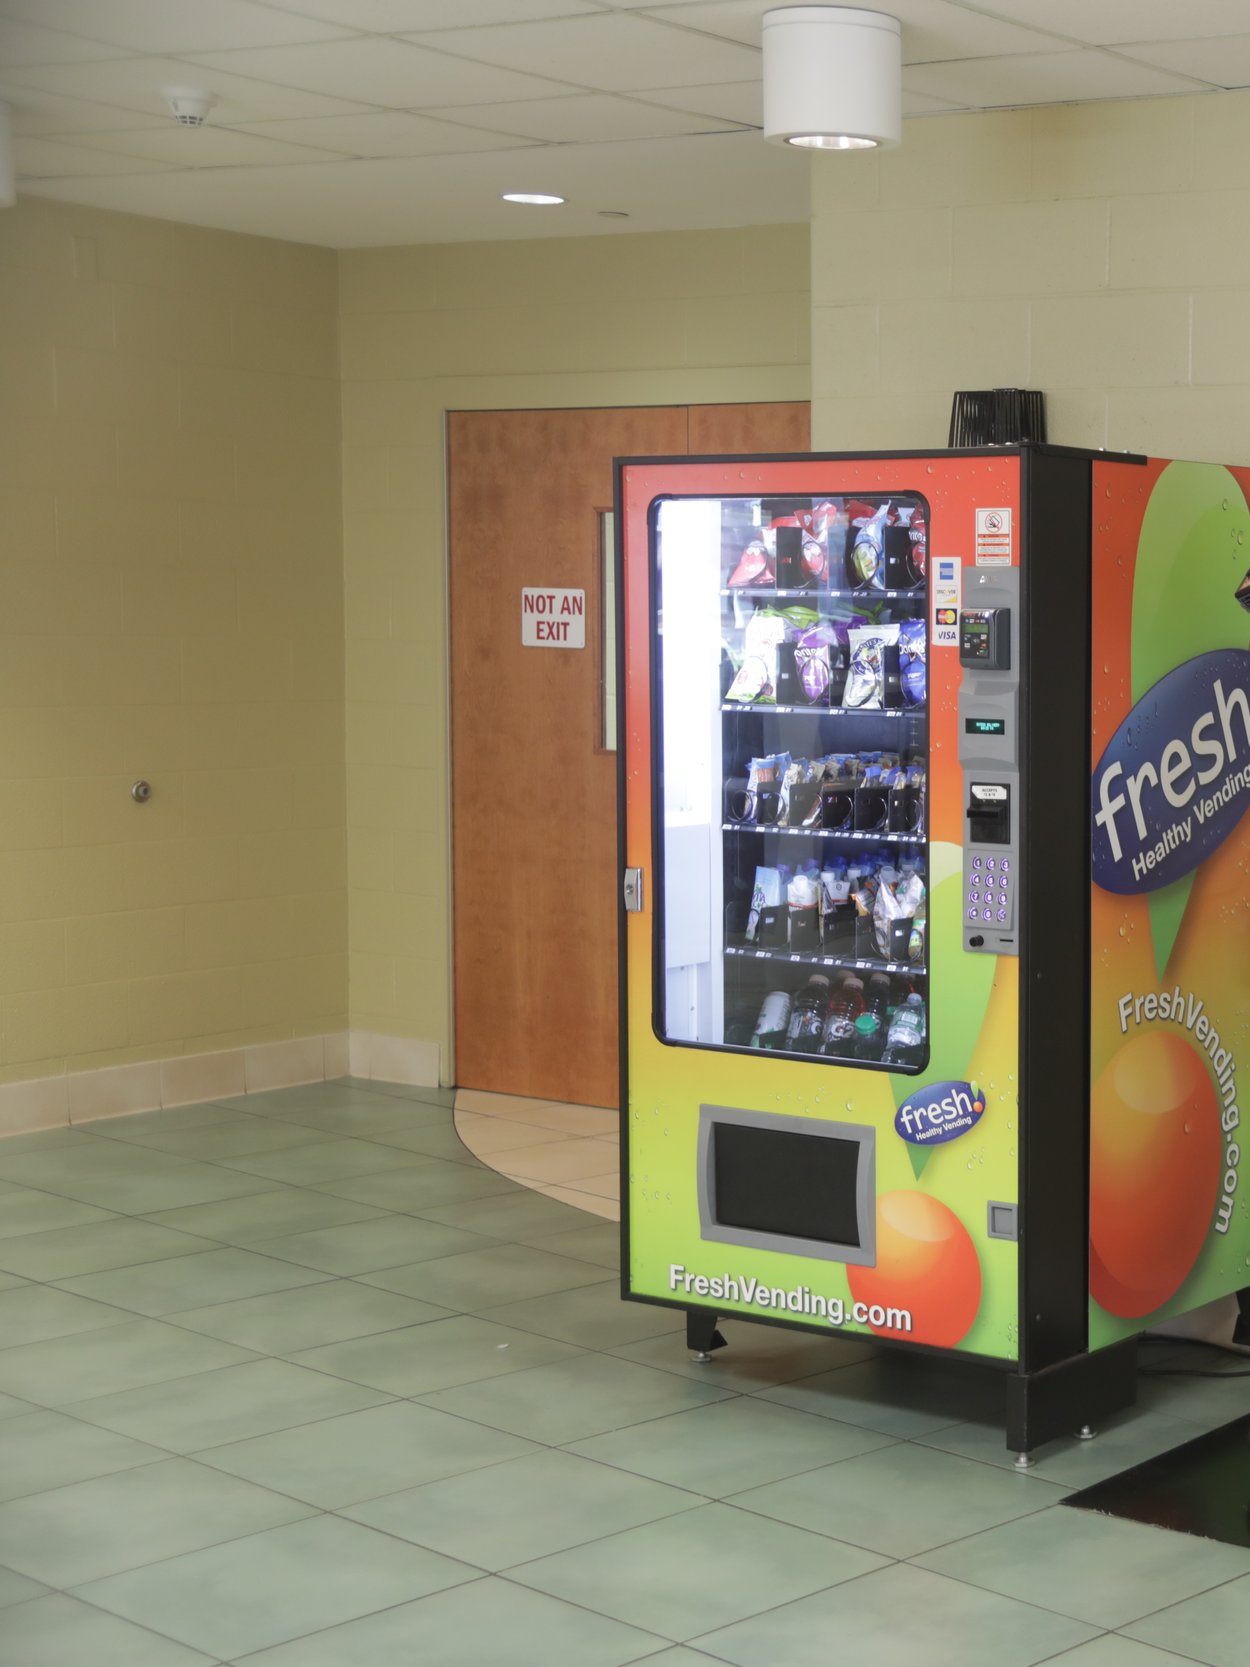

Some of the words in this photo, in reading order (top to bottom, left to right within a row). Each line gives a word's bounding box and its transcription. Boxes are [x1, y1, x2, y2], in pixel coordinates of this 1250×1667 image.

[524, 594, 556, 614] NOT
[560, 595, 583, 615] AN
[536, 620, 570, 641] EXIT
[938, 631, 957, 640] VISA
[1131, 816, 1192, 881] Healthy
[1117, 985, 1240, 1235] FreshVending.com
[915, 1125, 943, 1141] Healthy
[943, 1115, 972, 1133] Vending
[669, 1263, 912, 1332] FreshVending.com
